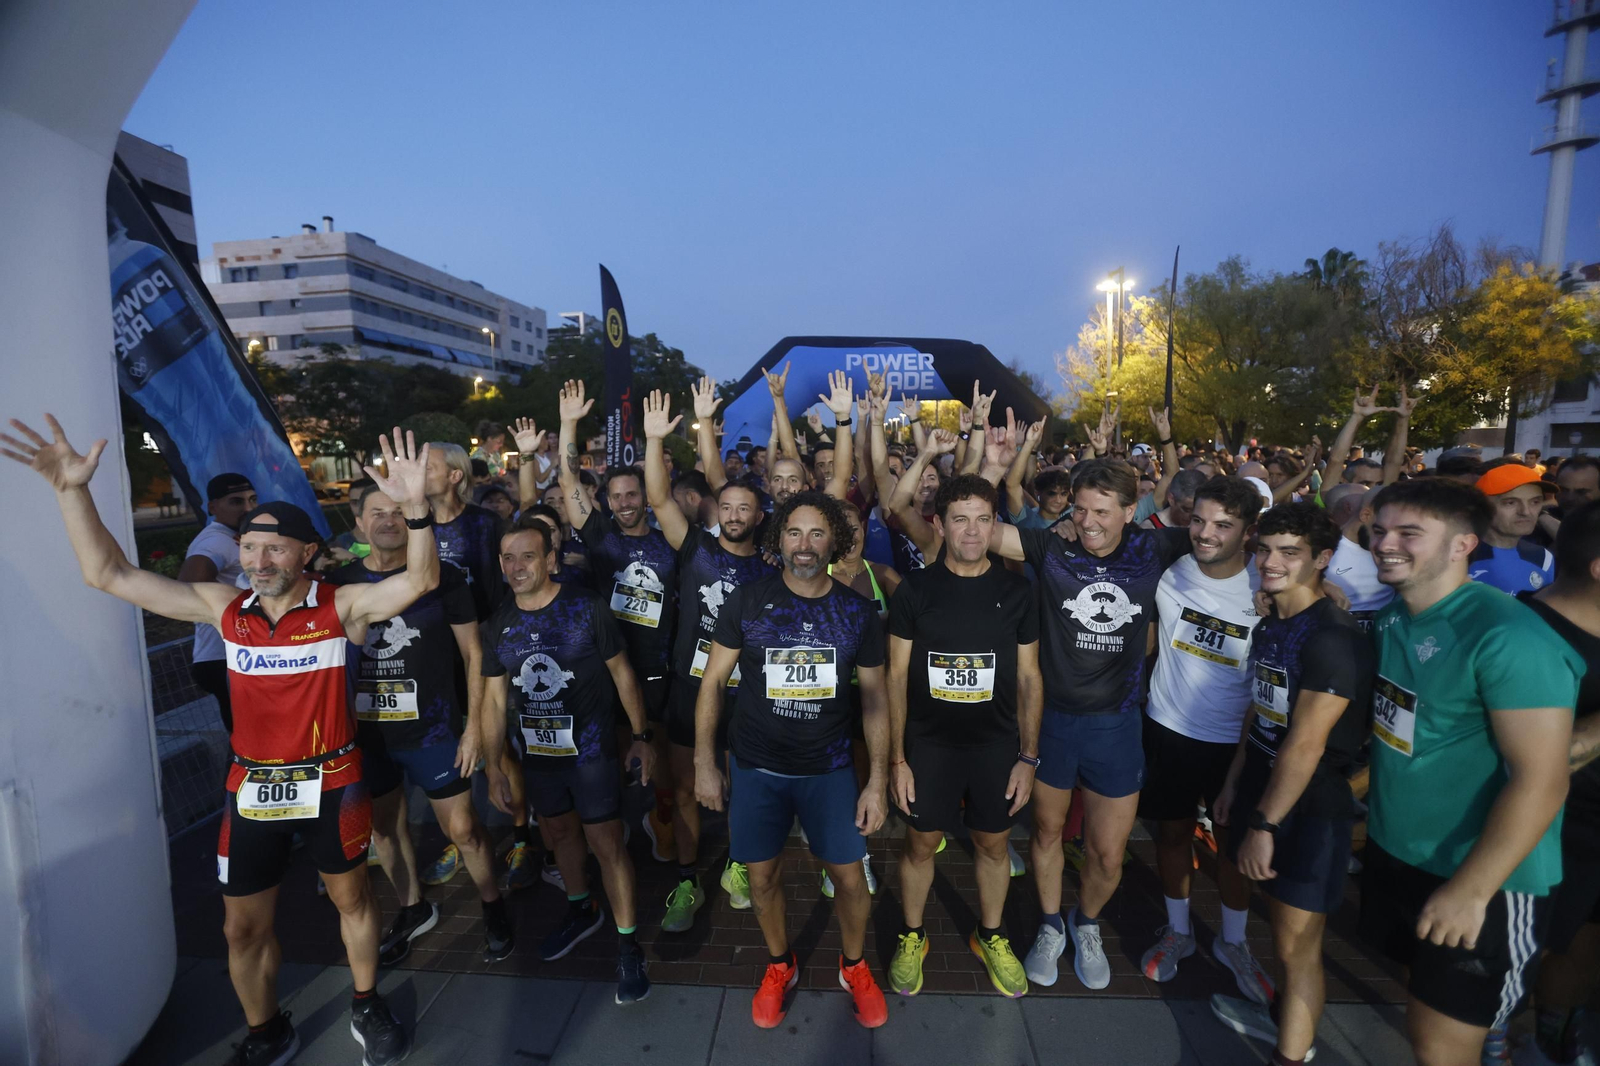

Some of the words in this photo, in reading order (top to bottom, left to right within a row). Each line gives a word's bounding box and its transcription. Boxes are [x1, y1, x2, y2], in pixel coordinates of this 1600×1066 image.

[846, 353, 935, 371] POWER
[886, 371, 935, 390] ADE
[624, 597, 648, 613] 220
[290, 629, 330, 641] FRANCISCO
[1077, 632, 1096, 643] NIGHT
[1096, 634, 1124, 645] RUNNING
[1194, 626, 1226, 650] 341
[1108, 644, 1123, 652] 2025
[254, 654, 318, 669] Avanza
[785, 665, 818, 683] 204
[945, 669, 978, 686] 358
[1257, 680, 1275, 704] 340
[369, 693, 398, 708] 796
[774, 699, 793, 710] NIGHT
[793, 700, 822, 713] RUNNING
[1376, 695, 1398, 727] 342
[535, 730, 557, 744] 597
[257, 782, 298, 803] 606
